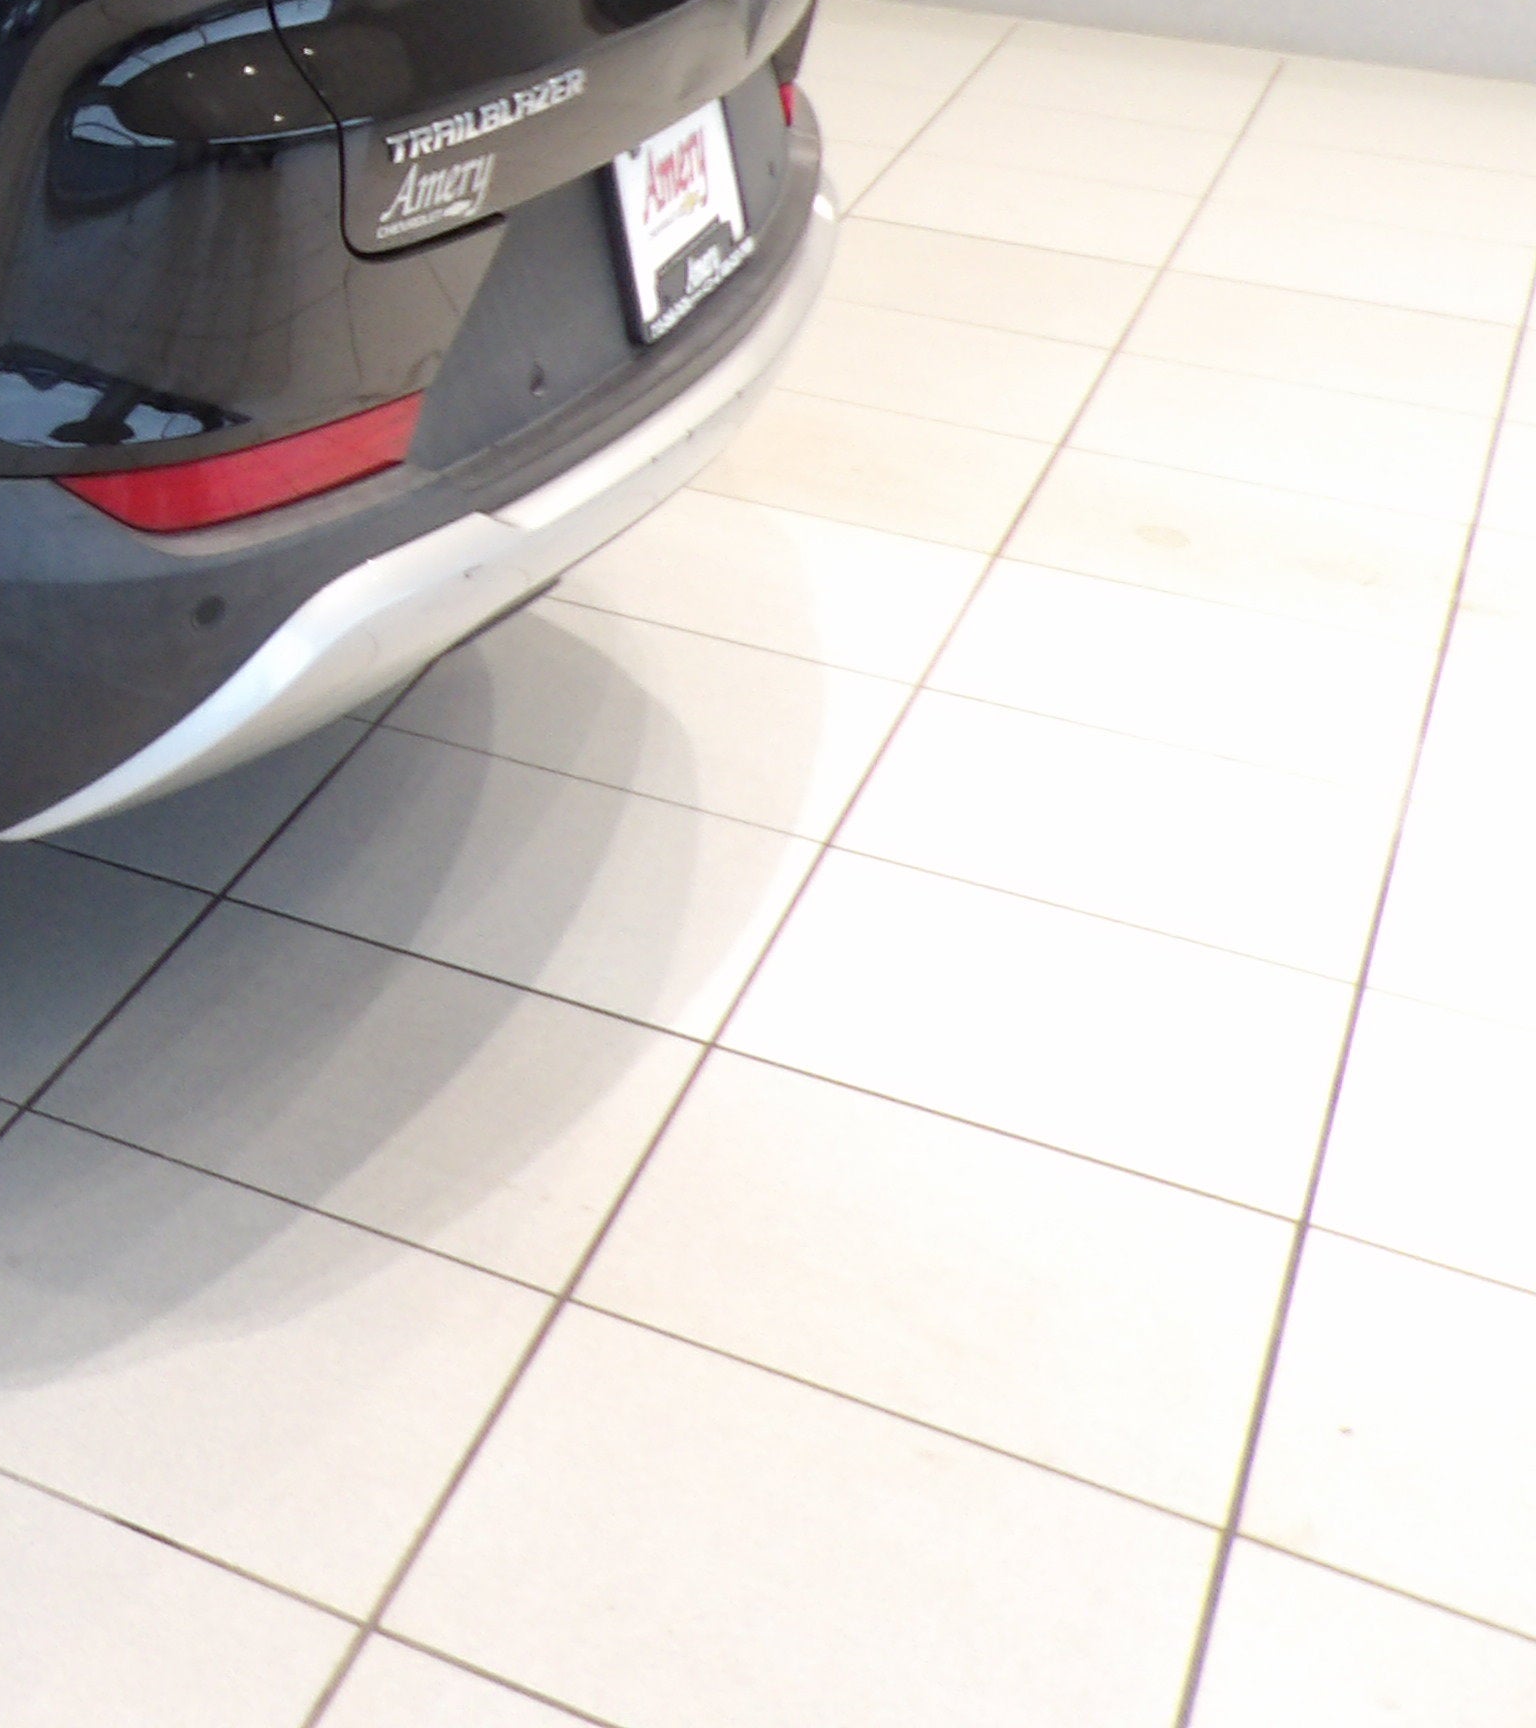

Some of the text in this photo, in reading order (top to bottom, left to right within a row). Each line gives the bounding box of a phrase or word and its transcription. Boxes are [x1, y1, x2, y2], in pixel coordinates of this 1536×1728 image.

[385, 68, 588, 164] TRAILBLAZER
[378, 152, 496, 224] Amery
[643, 126, 709, 227] Amery
